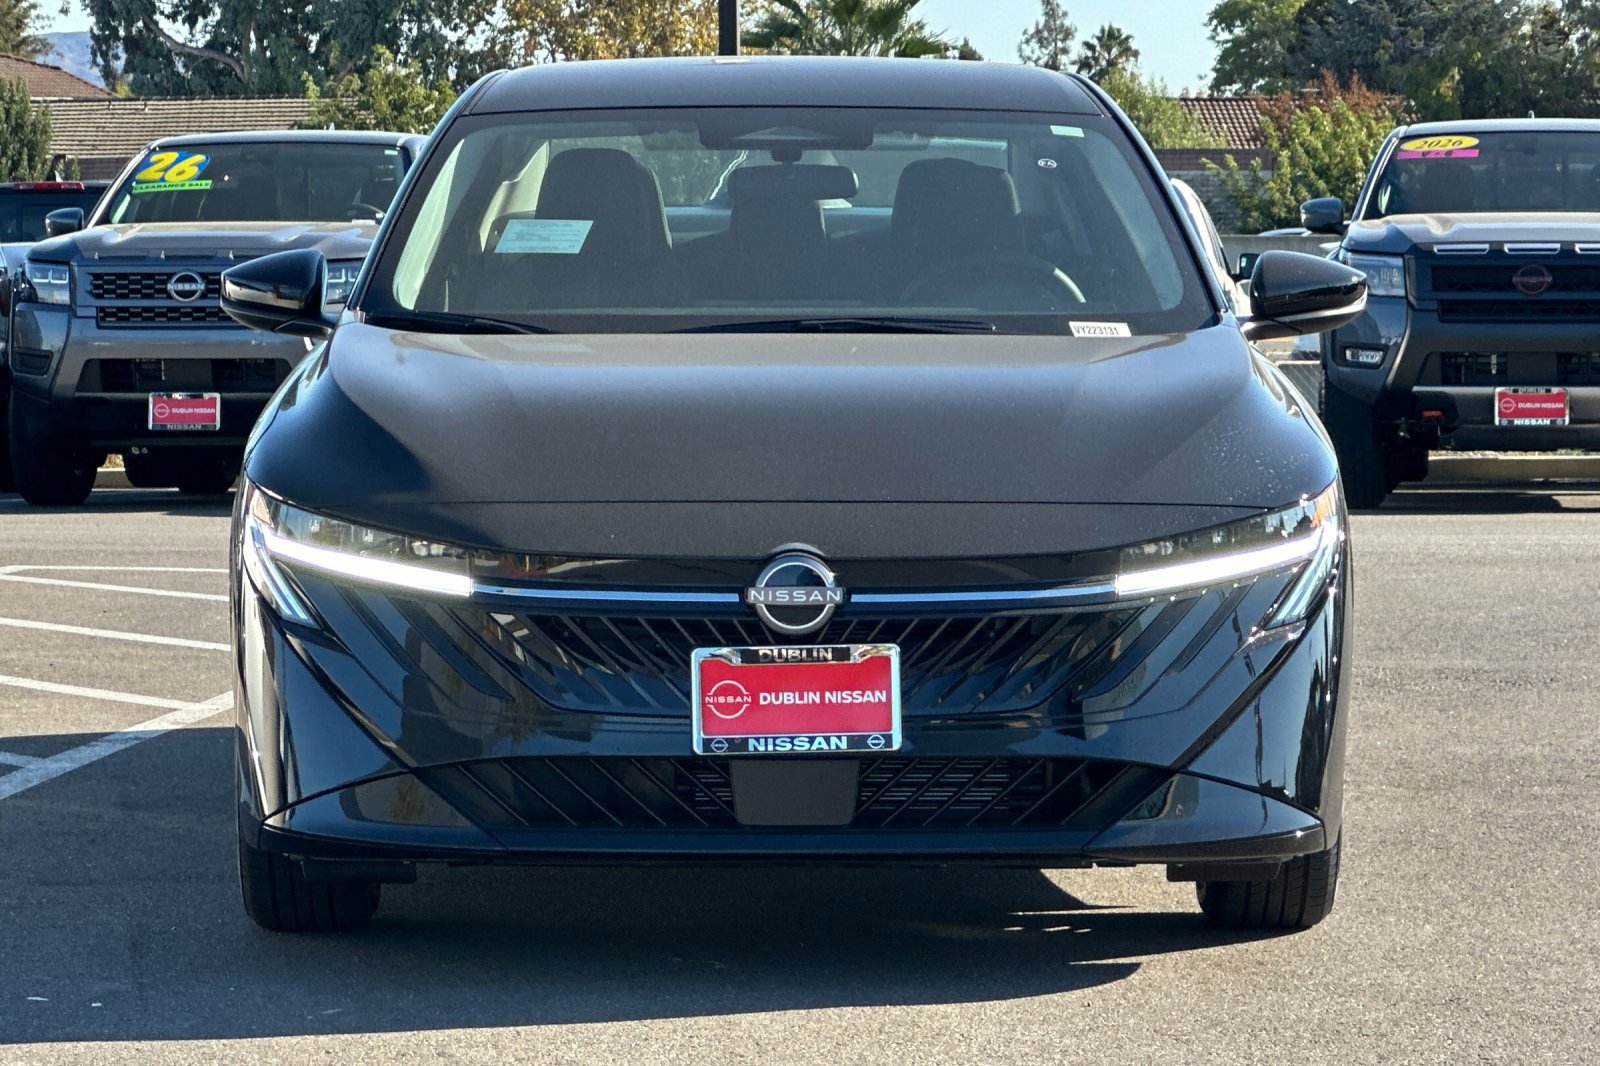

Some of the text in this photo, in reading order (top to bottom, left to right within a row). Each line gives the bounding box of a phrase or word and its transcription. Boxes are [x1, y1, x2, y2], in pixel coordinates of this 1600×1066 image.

[1415, 139, 1463, 149] 2026
[135, 152, 206, 182] 26
[134, 183, 186, 191] CLEARANCE
[1073, 325, 1119, 336] VY223131
[750, 590, 841, 602] NISSAN
[759, 648, 832, 662] DUBLIN
[705, 695, 752, 704] NISSAN
[759, 690, 887, 705] DUBLIN NISSAN
[748, 736, 848, 752] NISSAN
